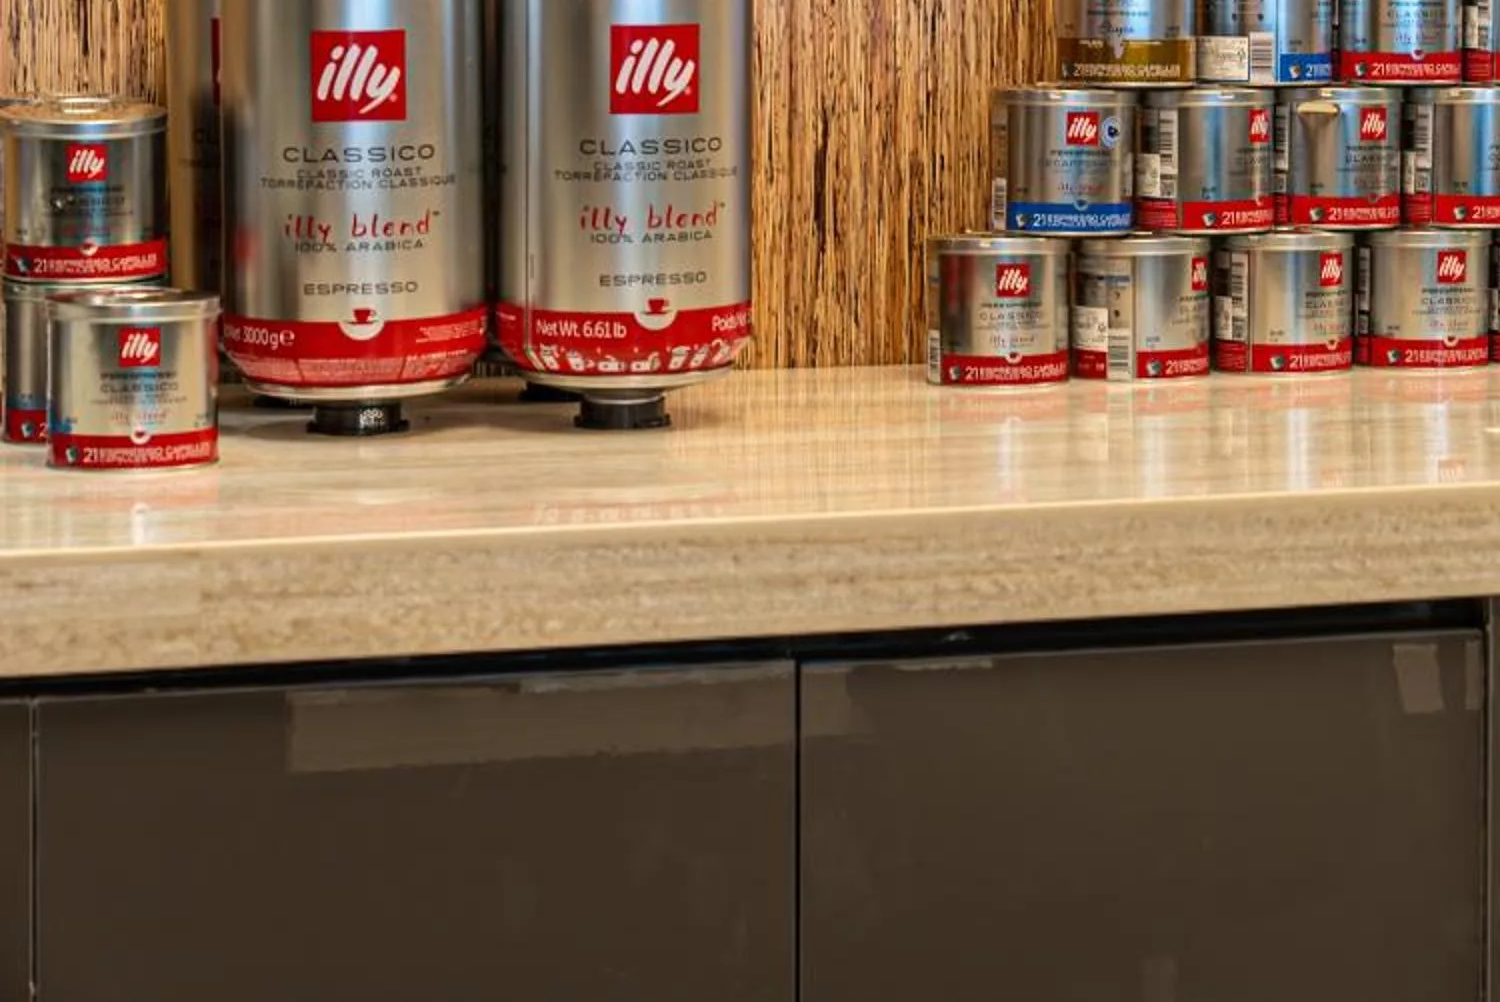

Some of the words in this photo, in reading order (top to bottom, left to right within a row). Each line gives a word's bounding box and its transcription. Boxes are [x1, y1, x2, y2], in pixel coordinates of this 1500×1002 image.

[317, 44, 400, 114] illy
[616, 38, 695, 107] illy
[1068, 117, 1097, 143] illy
[1250, 114, 1268, 140] illy
[1362, 112, 1385, 137] illy
[283, 144, 435, 163] CLASSICO
[579, 137, 722, 155] CLASSICO
[69, 149, 105, 178] illy
[297, 167, 364, 180] CLASSIC
[371, 166, 421, 178] ROAST
[594, 161, 660, 172] CLASSIC
[667, 159, 711, 170] ROAST
[284, 213, 332, 243] illy
[351, 208, 431, 238] blend
[579, 205, 628, 238] illy
[647, 200, 718, 229] blend
[346, 239, 423, 252] ARABICA
[641, 230, 713, 243] ARABICA
[600, 271, 707, 287] ESPRESSO
[1321, 258, 1342, 283] illy
[1439, 255, 1465, 280] illy
[304, 281, 419, 296] ESPRESSO
[998, 269, 1028, 294] illy
[121, 333, 159, 364] illy
